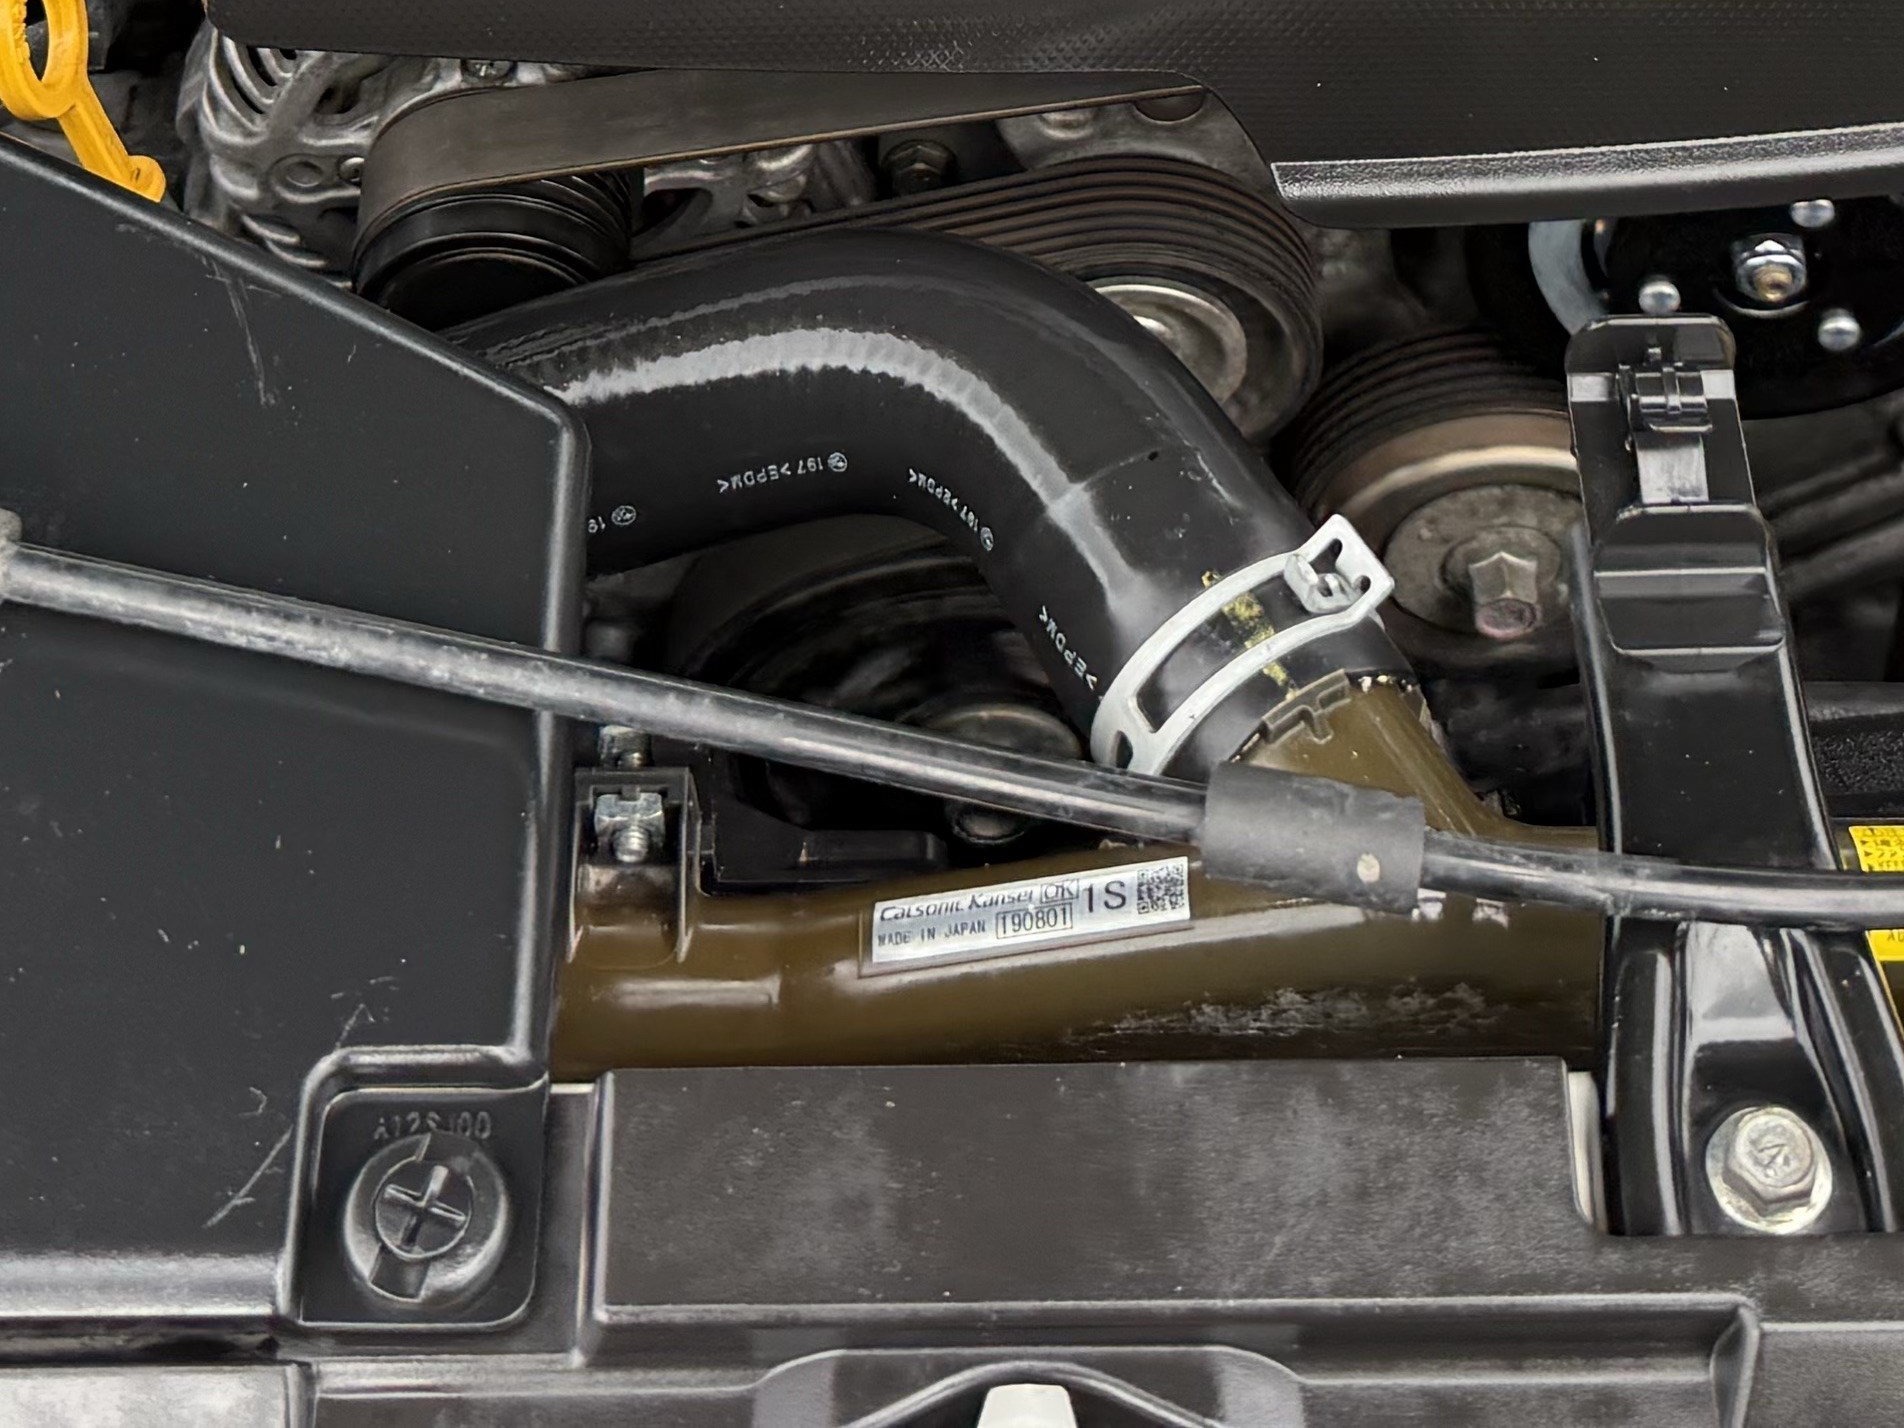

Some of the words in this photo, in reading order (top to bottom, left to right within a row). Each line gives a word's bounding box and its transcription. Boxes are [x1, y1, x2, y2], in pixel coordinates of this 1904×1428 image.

[880, 897, 964, 922] Calsonic
[967, 888, 1034, 911] Kansei
[877, 930, 911, 947] MADE
[920, 926, 936, 942] IN
[944, 919, 986, 937] JAPAN
